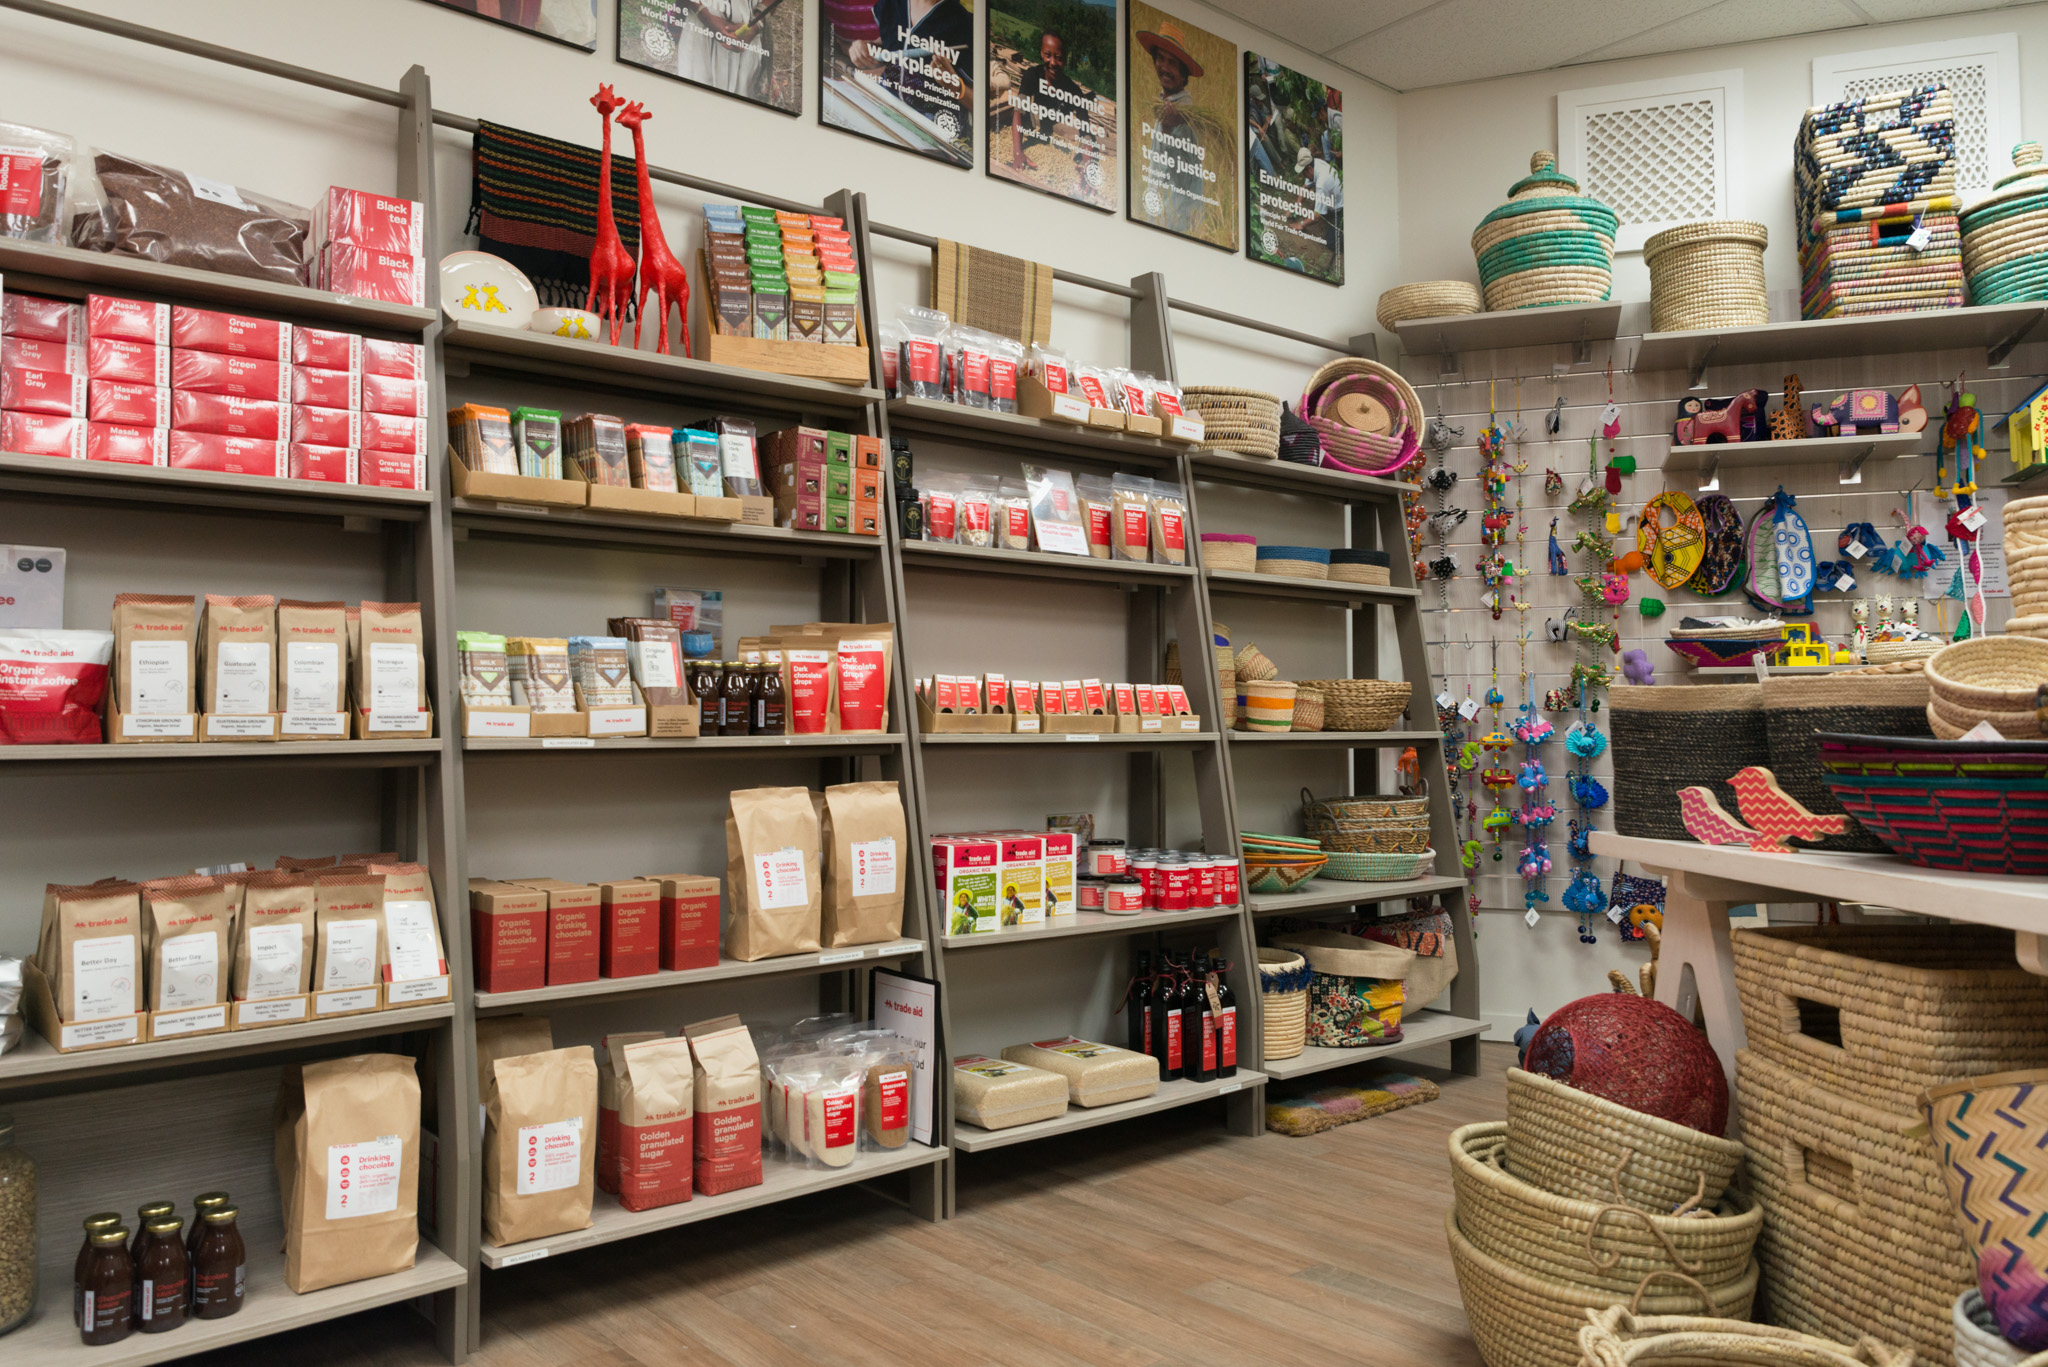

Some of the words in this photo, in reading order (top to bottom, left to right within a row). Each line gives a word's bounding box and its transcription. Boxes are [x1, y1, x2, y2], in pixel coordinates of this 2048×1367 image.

[682, 7, 689, 16] 6
[640, 6, 668, 22] World
[669, 16, 686, 28] Fair
[688, 22, 715, 38] Trade
[716, 32, 770, 57] Organization
[897, 25, 960, 66] Healthy
[867, 43, 960, 87] workplaces
[854, 68, 878, 84] World
[878, 75, 893, 88] Fair
[894, 80, 915, 96] Trade
[916, 89, 961, 112] Organization
[924, 80, 955, 100] Principle
[955, 90, 960, 100] 7
[1039, 78, 1106, 116] Economic
[1008, 90, 1106, 138] independence
[1016, 124, 1036, 138] World
[1036, 131, 1048, 142] Fair
[1050, 136, 1067, 148] Trade
[1068, 142, 1106, 161] Organization
[1074, 134, 1101, 151] Principle
[1142, 122, 1206, 162] Promoting
[1142, 146, 1175, 170] trade
[1176, 156, 1217, 184] justice
[0, 156, 10, 190] Rooibos
[1142, 165, 1166, 180] Principle
[1142, 175, 1158, 186] World
[1159, 180, 1170, 190] Fair
[1170, 183, 1186, 196] Trade
[1186, 188, 1220, 207] Organization
[1259, 168, 1335, 208] Environmental
[376, 200, 408, 215] Black
[1259, 192, 1316, 221] protection
[389, 213, 408, 226] tea
[1260, 208, 1281, 222] Principle
[1281, 214, 1288, 222] 10
[1260, 218, 1276, 230] World
[1276, 222, 1285, 232] Fair
[1284, 225, 1298, 236] Trade
[1298, 230, 1328, 246] Organization
[379, 255, 410, 270] Black
[391, 269, 410, 280] tea
[228, 318, 257, 330] Green
[229, 326, 244, 335] tea
[22, 342, 38, 352] Earl
[112, 342, 142, 354] Masala
[22, 350, 42, 360] Grey
[25, 371, 43, 380] Earl
[25, 379, 47, 390] Grey
[114, 385, 142, 396] Masala
[114, 392, 131, 402] chai
[378, 458, 399, 468] Green
[400, 461, 411, 469] tea
[379, 466, 394, 474] with
[395, 467, 410, 475] mint
[377, 658, 404, 666] Nicaragua
[0, 664, 46, 676] Organic
[843, 670, 864, 679] drops
[0, 674, 39, 685] instant
[42, 675, 78, 686] coffee
[618, 906, 646, 917] Organic
[681, 902, 708, 912] Organic
[179, 917, 199, 926] trade
[200, 914, 213, 922] aid
[556, 912, 586, 922] Organic
[681, 910, 701, 919] cocoa
[88, 918, 113, 928] trade
[114, 917, 128, 925] aid
[498, 919, 531, 929] Organic
[556, 920, 587, 931] drinking
[618, 916, 640, 925] cocoa
[498, 927, 532, 938] drinking
[555, 929, 592, 939] chocolate
[498, 936, 537, 946] chocolate
[81, 958, 102, 966] Better
[104, 956, 118, 965] Day
[189, 953, 201, 962] Day
[894, 1002, 912, 1014] trade
[913, 1006, 923, 1017] aid
[882, 1082, 906, 1090] Muscovado
[728, 1097, 745, 1105] trade
[656, 1112, 676, 1120] trade
[714, 1115, 742, 1126] Golden
[714, 1120, 754, 1136] granulated
[544, 1134, 571, 1143] Drinking
[640, 1130, 670, 1141] Golden
[714, 1133, 737, 1144] sugar
[544, 1140, 575, 1150] chocolate
[640, 1136, 684, 1152] granulated
[358, 1154, 391, 1165] Drinking
[640, 1149, 664, 1160] sugar
[358, 1161, 395, 1171] chocolate
[529, 1172, 535, 1181] 2
[341, 1195, 348, 1204] 2
